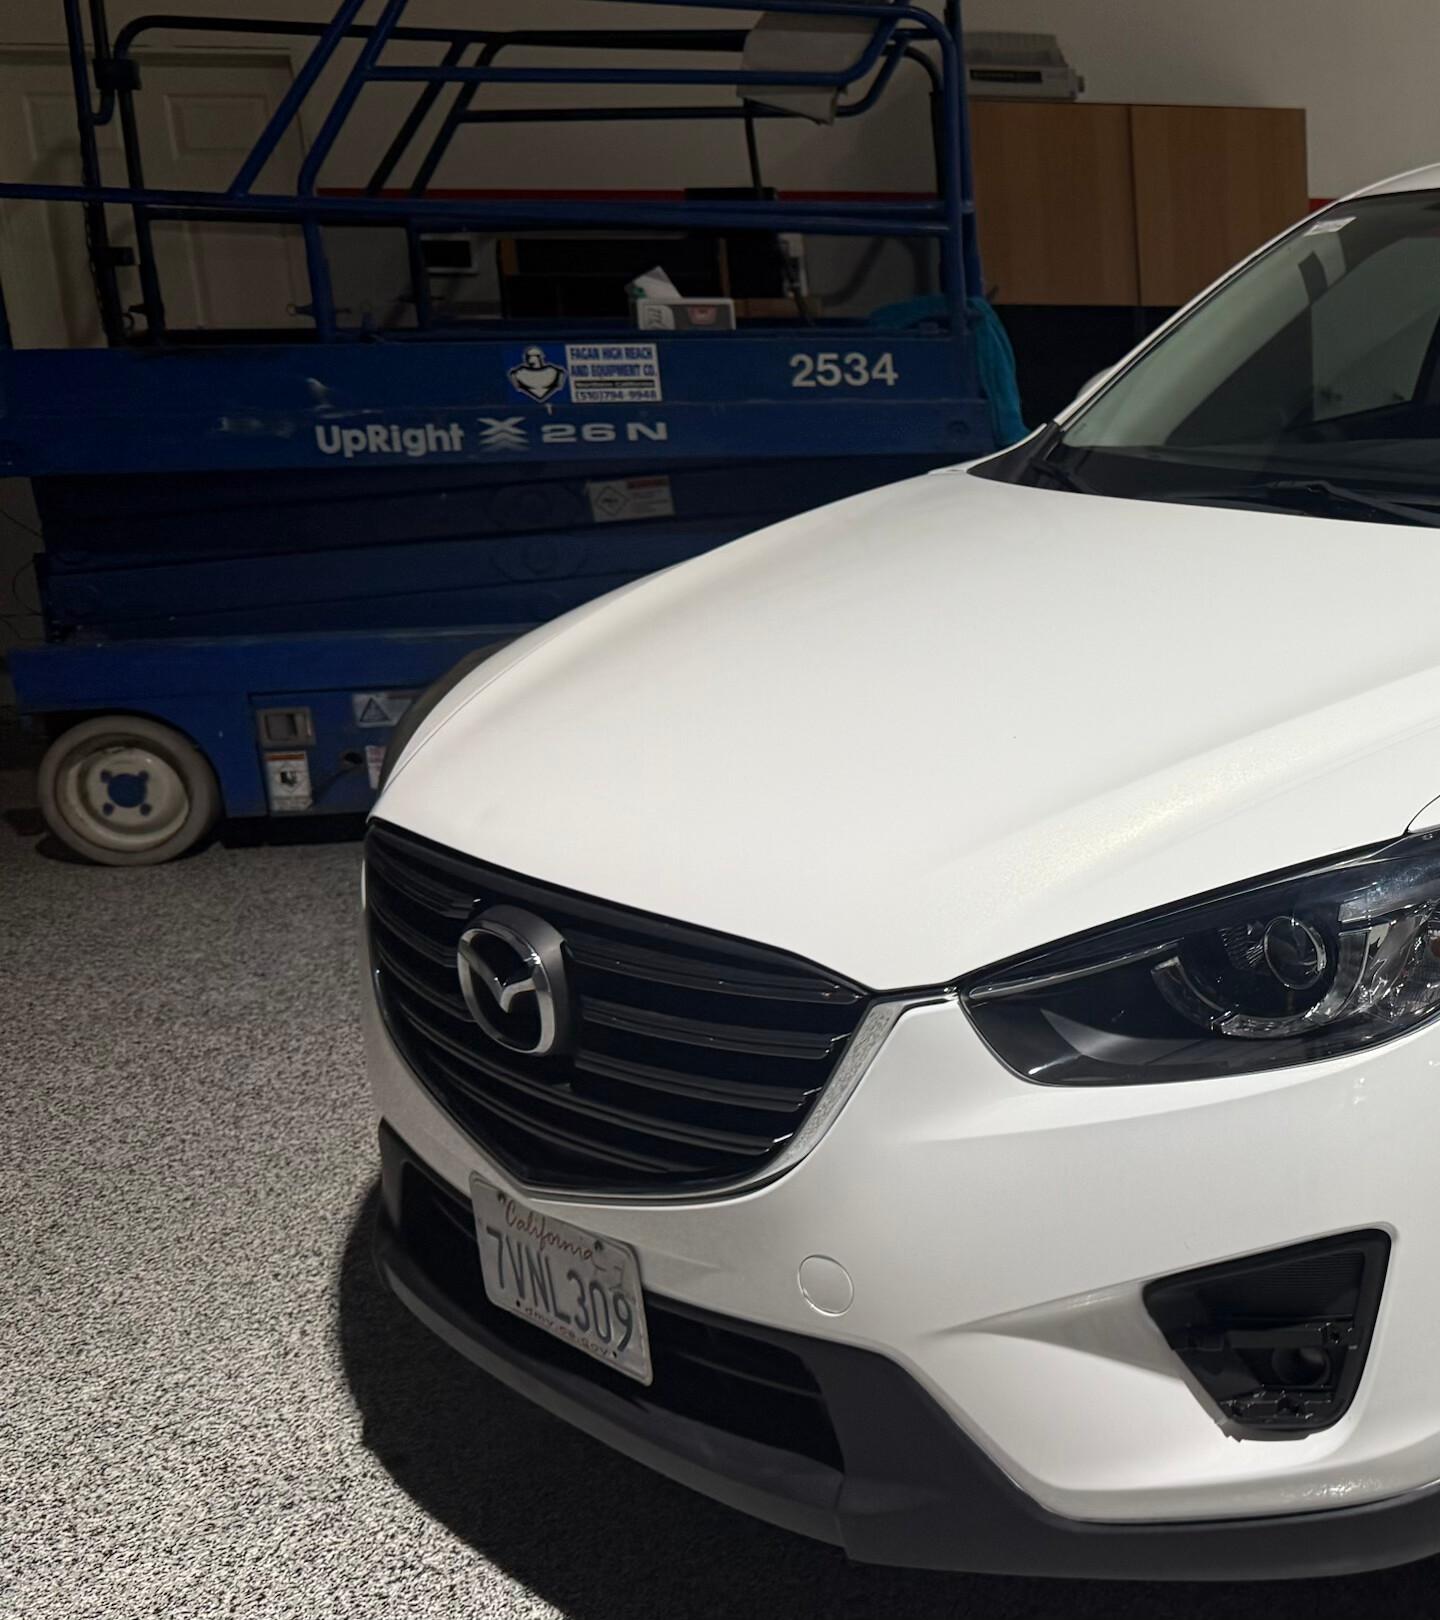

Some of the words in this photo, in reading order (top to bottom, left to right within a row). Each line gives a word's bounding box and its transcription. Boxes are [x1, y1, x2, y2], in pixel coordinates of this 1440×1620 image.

[570, 347, 599, 360] FAGAN
[602, 347, 621, 360] HIGH
[624, 347, 653, 359] REACH
[789, 352, 899, 387] 2534
[571, 365, 589, 377] AND
[591, 365, 640, 376] EQUIPMENT
[315, 424, 464, 456] UpRight
[505, 1199, 604, 1268] California
[486, 1226, 633, 1352] 7VNL309
